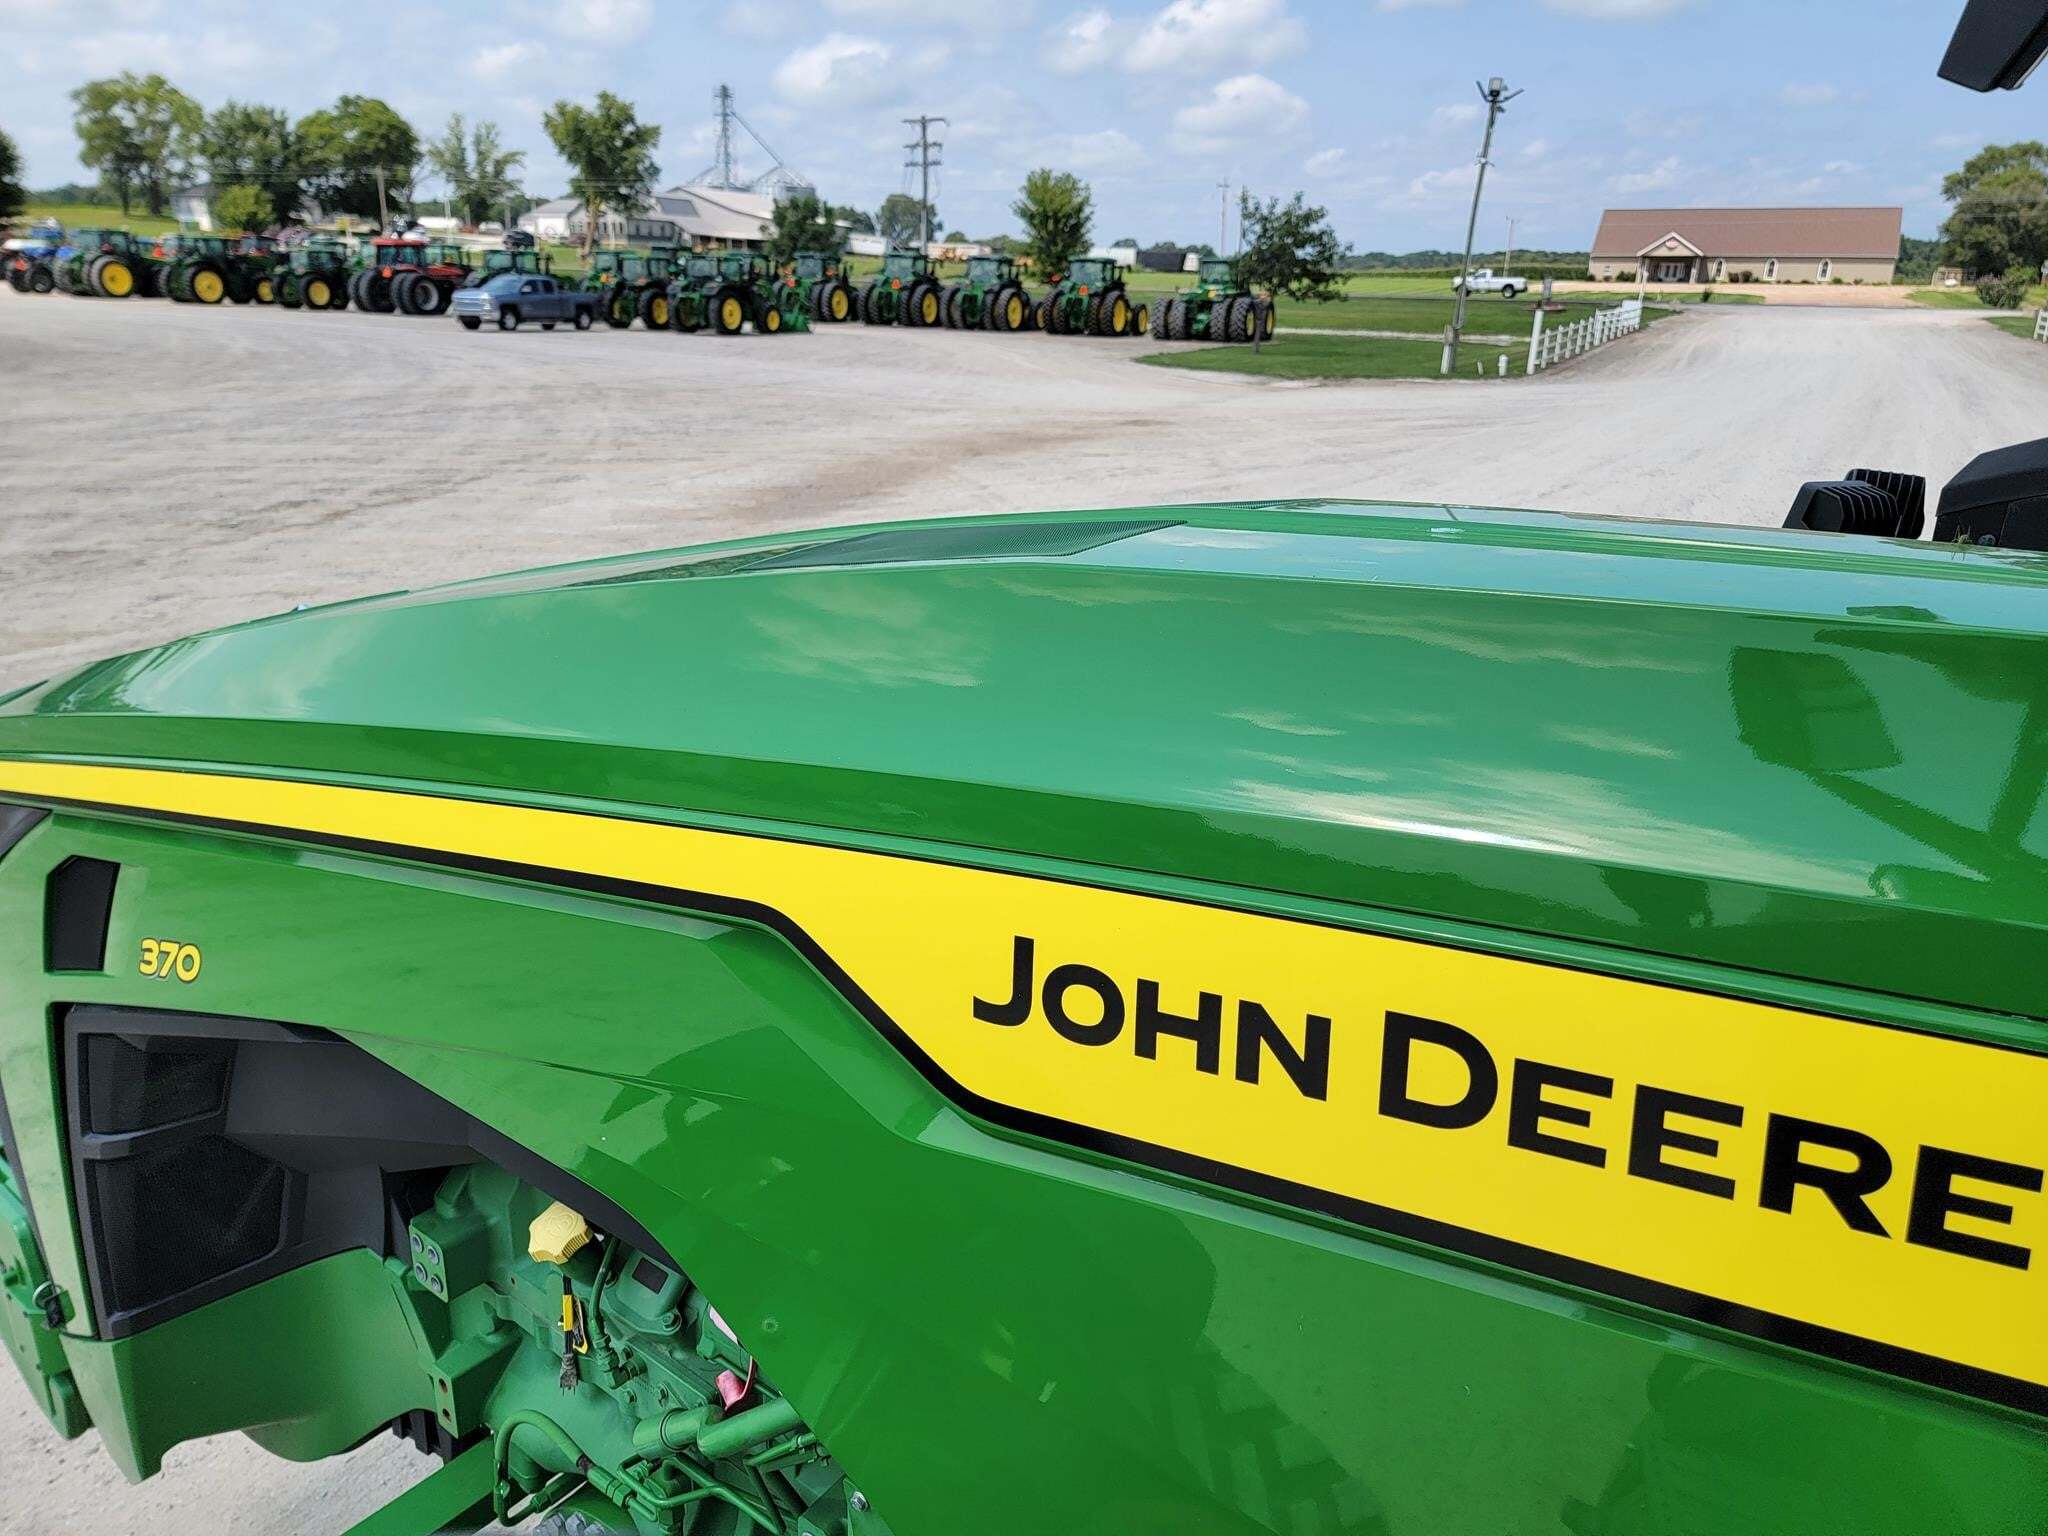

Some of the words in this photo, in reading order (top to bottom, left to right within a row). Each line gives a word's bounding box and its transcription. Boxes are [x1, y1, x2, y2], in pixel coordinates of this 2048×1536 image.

[139, 938, 202, 983] 370
[972, 935, 1332, 1102] JOHN
[1378, 1010, 2045, 1271] DEERE
